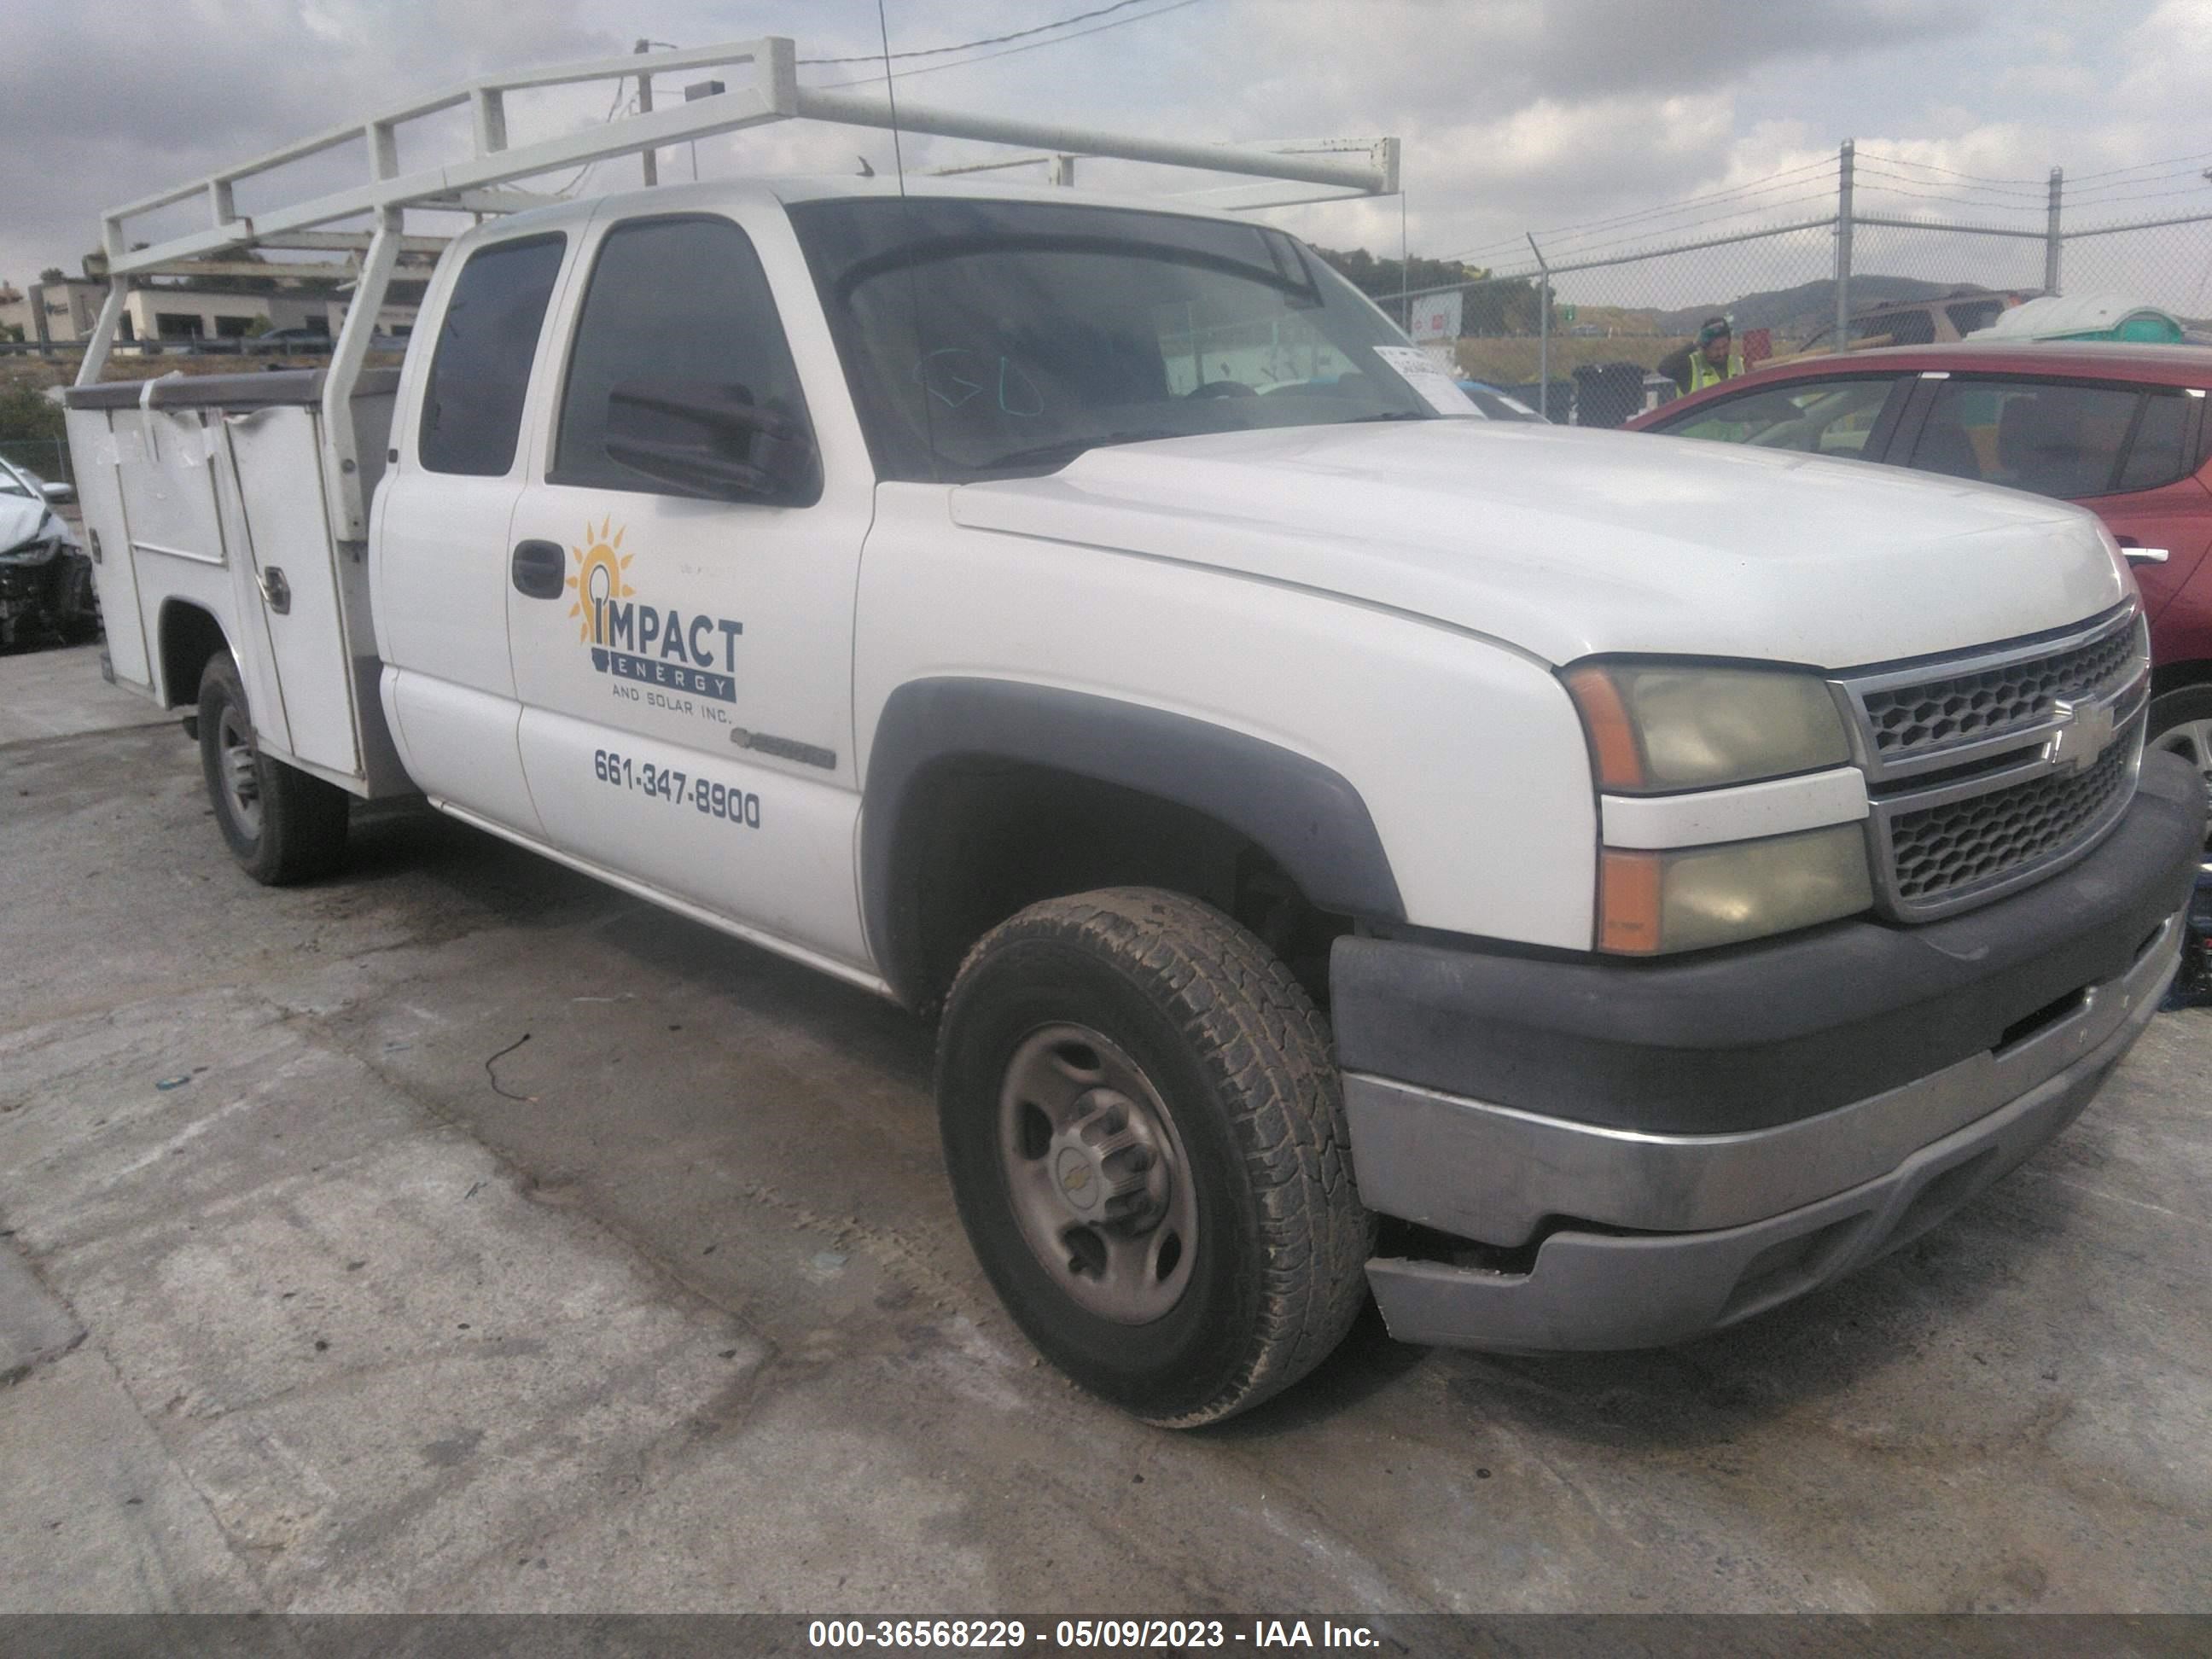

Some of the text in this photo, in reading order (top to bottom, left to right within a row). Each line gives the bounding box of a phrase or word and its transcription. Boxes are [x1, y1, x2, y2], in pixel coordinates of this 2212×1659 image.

[595, 597, 743, 672] IMPACT
[613, 684, 732, 725] AND SOLAR INC.
[618, 658, 725, 696] ENERGY
[594, 749, 760, 830] 661-347-8900
